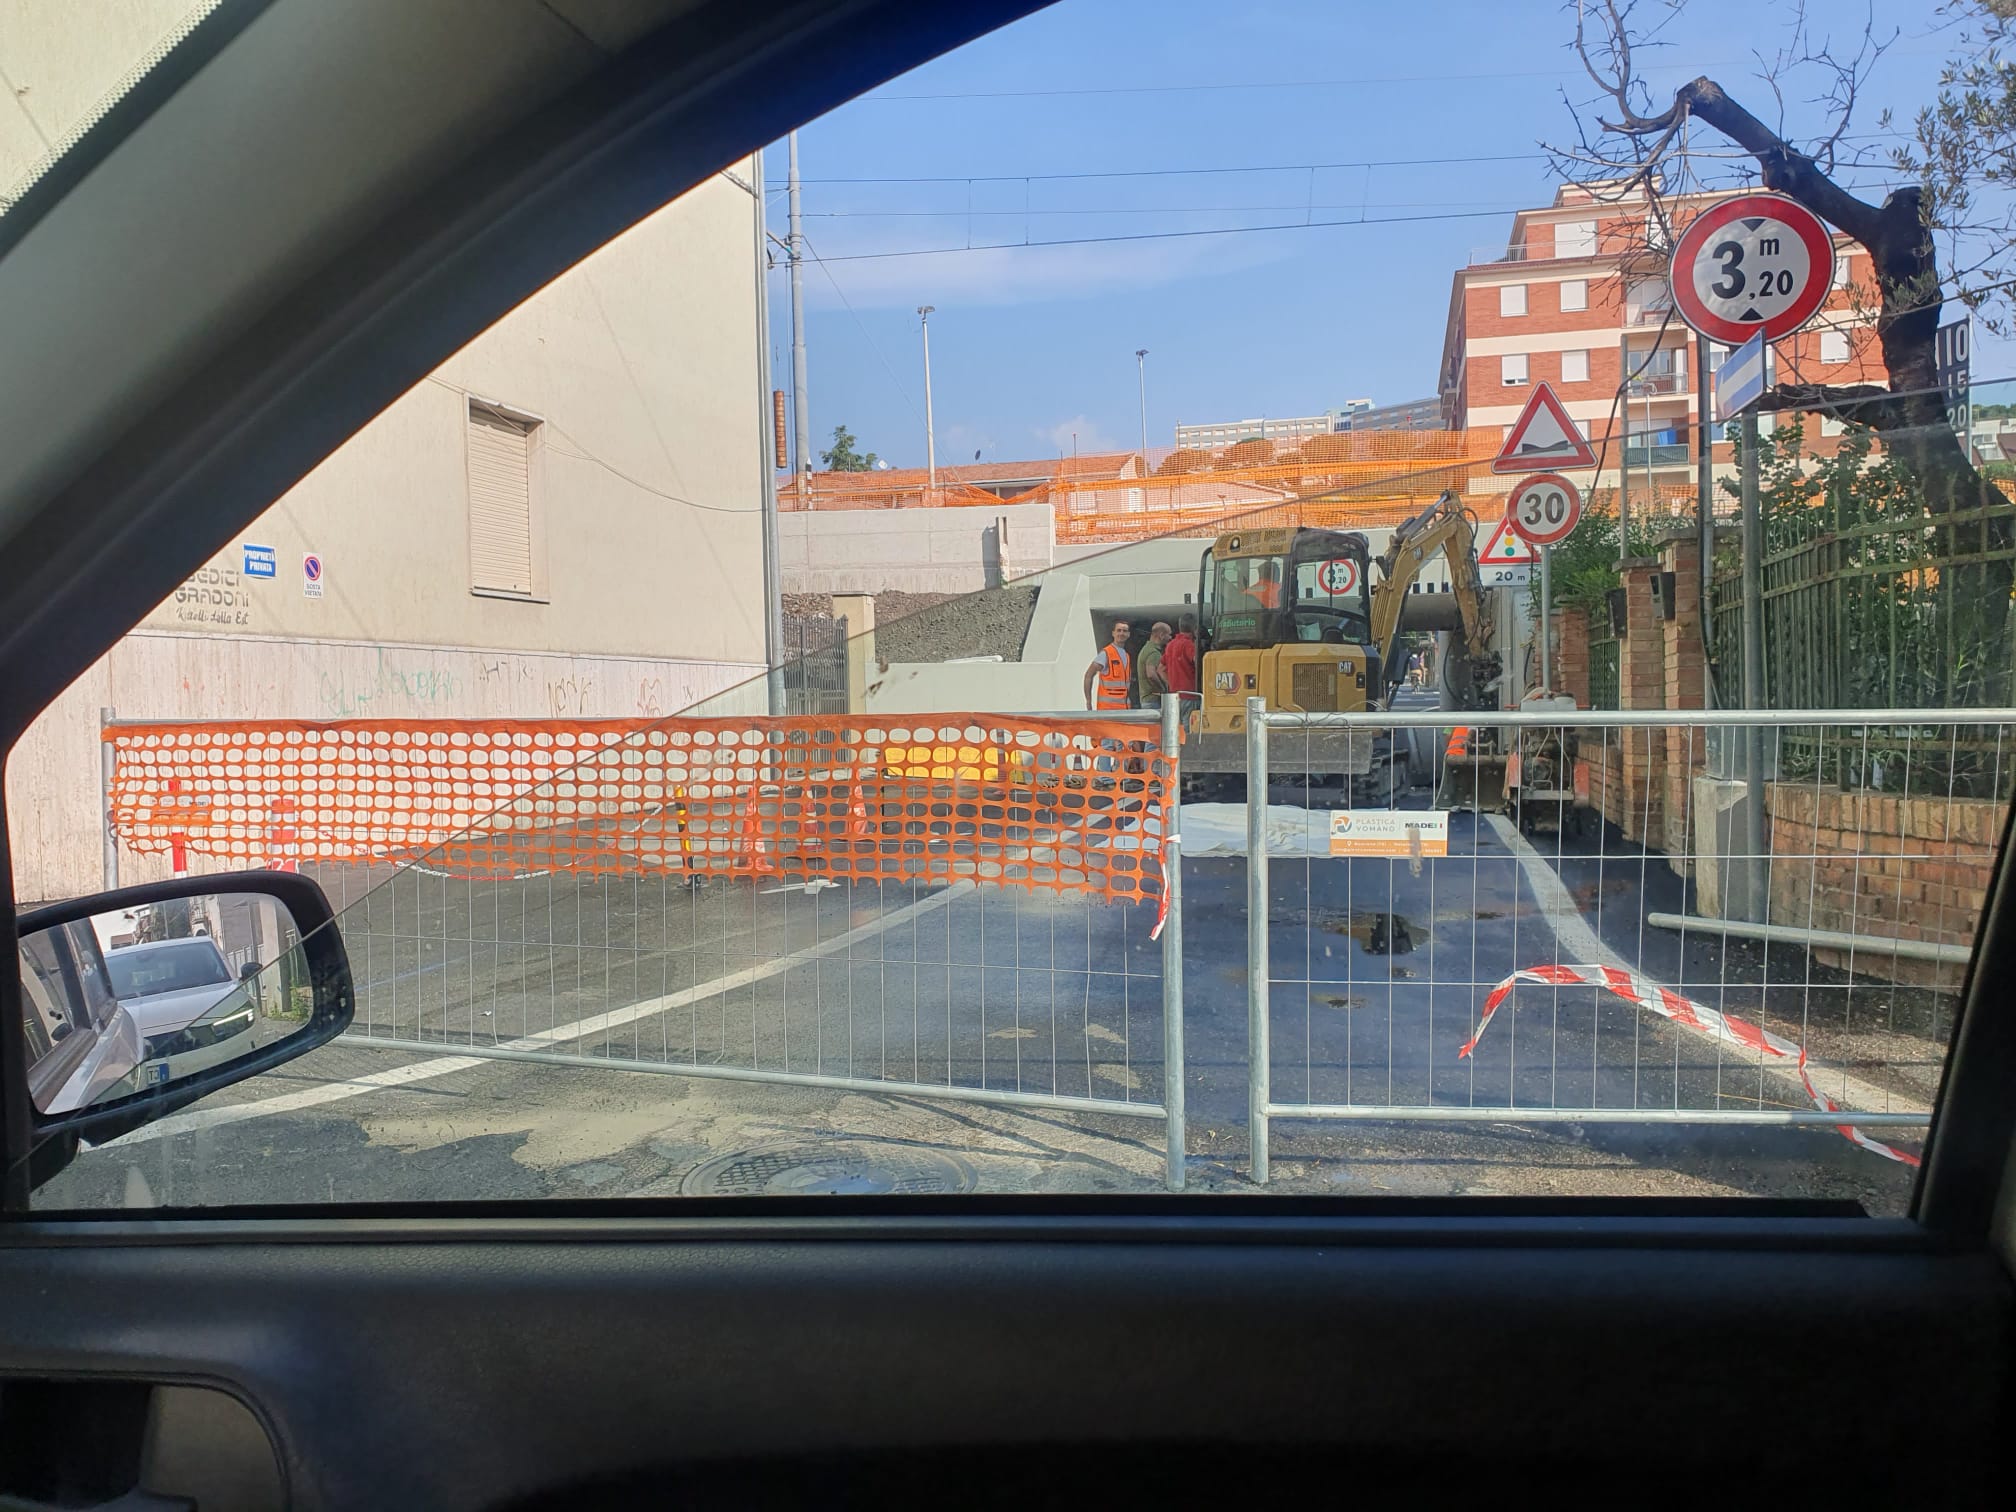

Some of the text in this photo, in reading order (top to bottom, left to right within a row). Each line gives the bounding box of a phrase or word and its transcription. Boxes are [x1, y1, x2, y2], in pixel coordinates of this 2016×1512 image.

[1760, 238, 1779, 256] m
[1524, 493, 1564, 525] 30
[1496, 572, 1513, 581] 20
[1339, 661, 1352, 673] CAT
[1216, 672, 1234, 689] CAT
